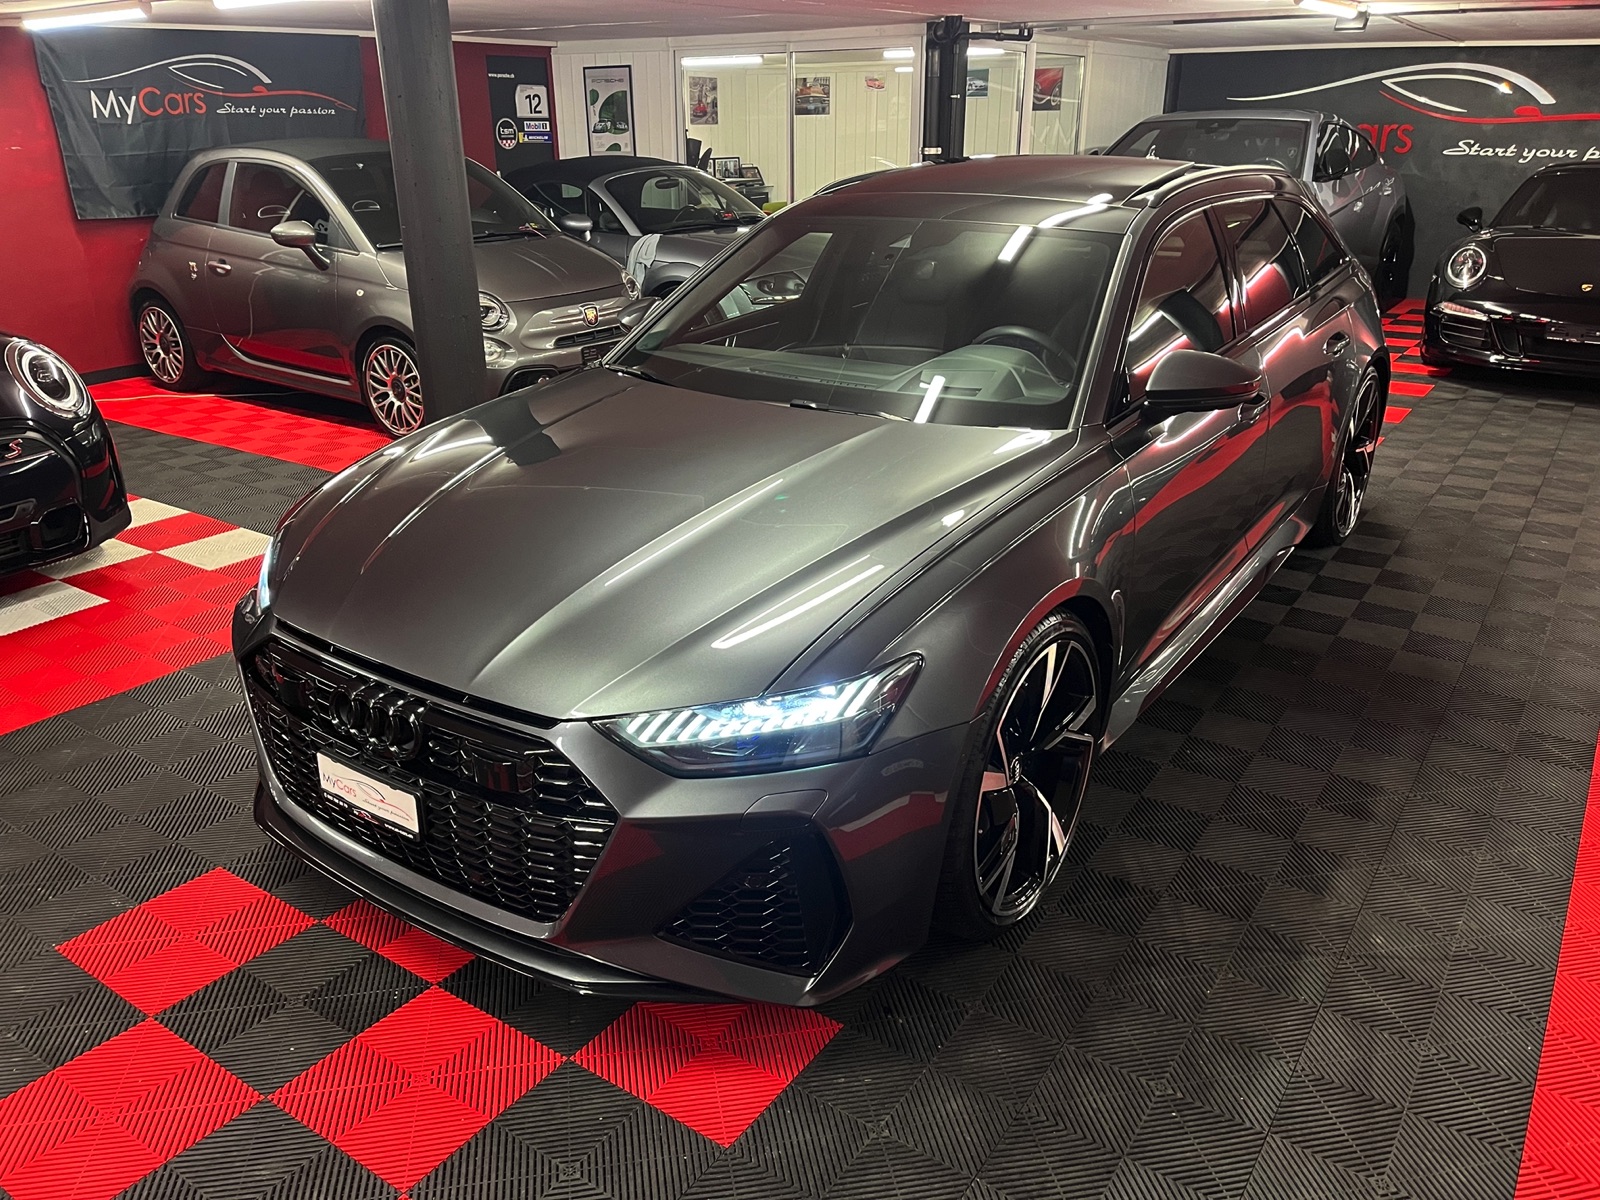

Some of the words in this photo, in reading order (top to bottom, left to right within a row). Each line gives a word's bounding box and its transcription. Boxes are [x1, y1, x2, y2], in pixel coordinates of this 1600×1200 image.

[90, 86, 207, 125] MyCars
[216, 102, 257, 114] Start
[259, 107, 287, 118] your
[289, 106, 336, 117] passion
[525, 93, 542, 115] 12
[525, 122, 542, 130] Mobil
[1357, 123, 1414, 154] ars
[1442, 139, 1518, 157] Start
[1518, 147, 1578, 164] your
[322, 772, 357, 798] MyCars
